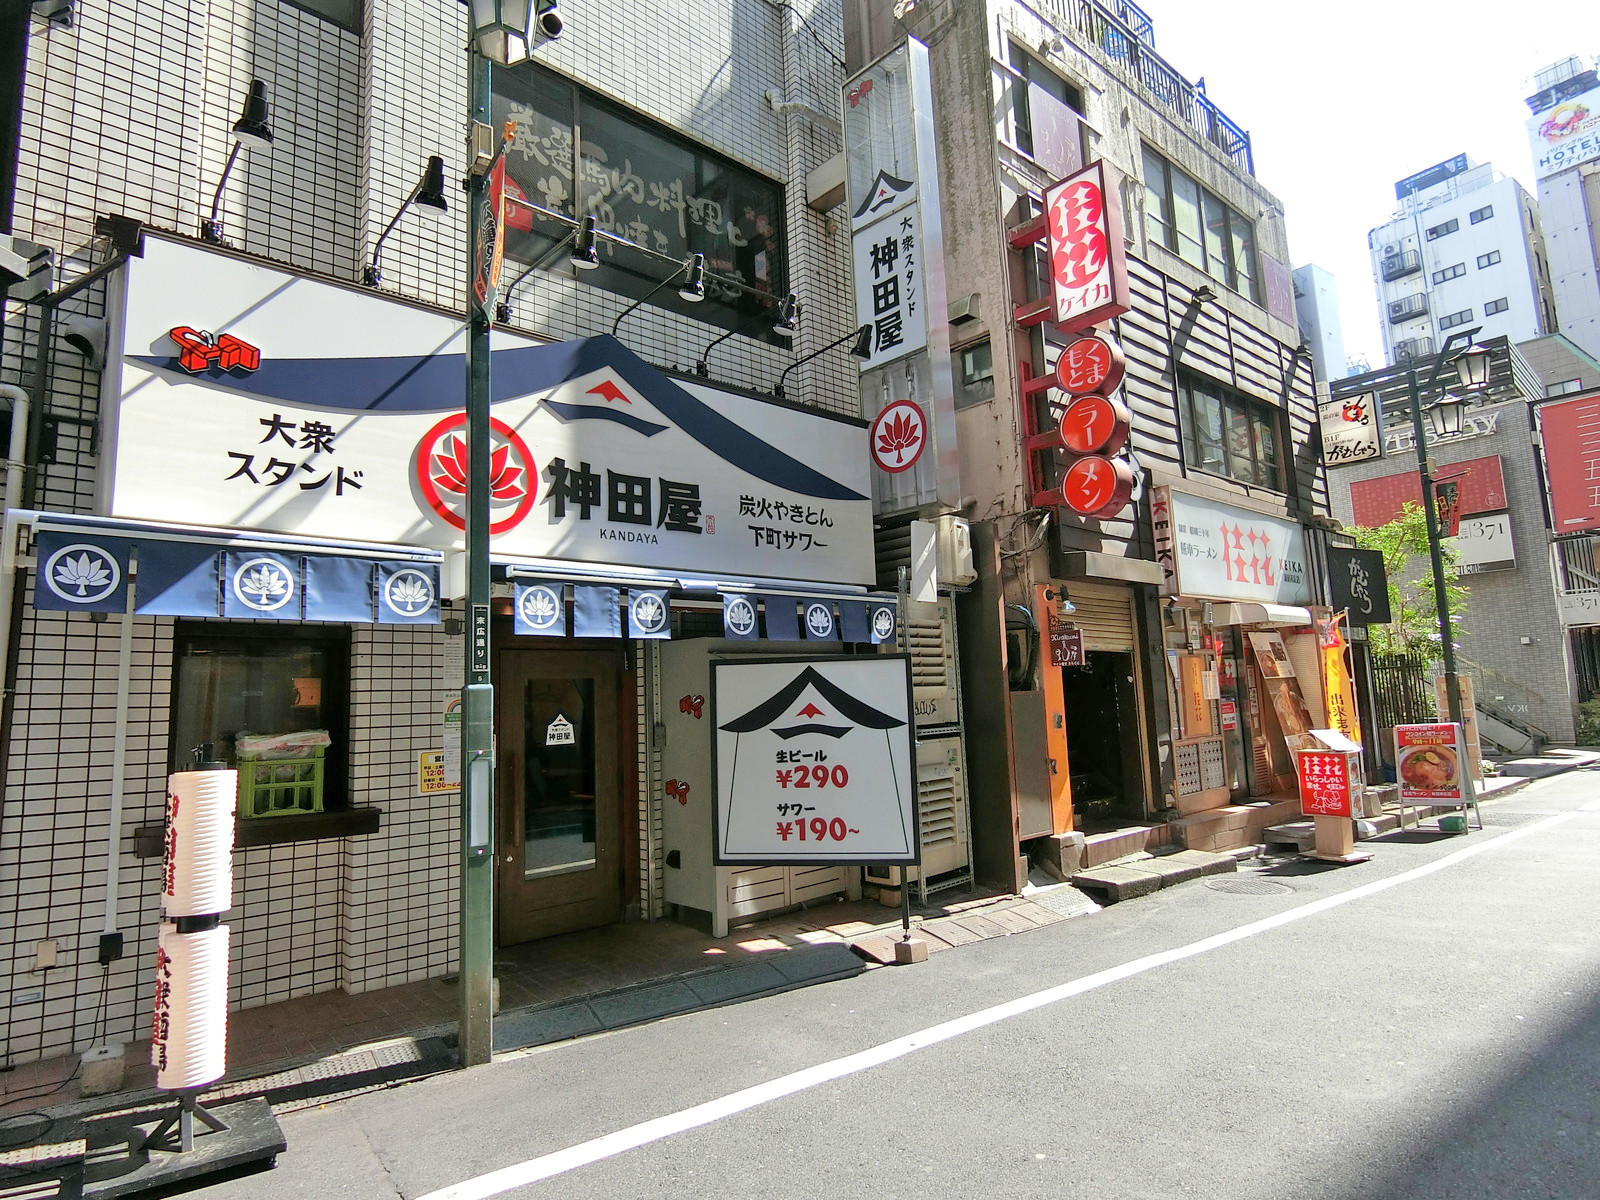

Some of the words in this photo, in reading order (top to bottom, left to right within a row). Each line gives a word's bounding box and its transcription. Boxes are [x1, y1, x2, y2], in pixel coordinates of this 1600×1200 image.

[900, 216, 916, 318] 大衆スタンド
[869, 236, 904, 354] 神田屋
[1059, 283, 1109, 316] ケイカ
[258, 413, 337, 454] 大衆
[1326, 441, 1377, 461] がむしゃら
[224, 451, 364, 496] スタンド
[546, 456, 703, 535] 神田屋
[738, 494, 834, 528] 炭火やきとん
[600, 528, 659, 545] KANDAYA
[748, 525, 829, 552] 下町サワー
[1152, 501, 1174, 579] KEIKA
[1473, 521, 1504, 541] 371
[1180, 541, 1218, 560] 熊本ラーメン
[1279, 558, 1303, 574] KEIKA
[1347, 557, 1373, 614] がむしゃら
[1576, 597, 1598, 610] 371
[476, 616, 486, 658] 末広通り
[549, 732, 571, 741] 神田屋
[775, 750, 828, 763] 生ビール
[1303, 756, 1342, 775] 桂花
[775, 764, 849, 789] ¥290
[1305, 775, 1344, 783] いらっしゃい
[776, 803, 816, 817] サワー
